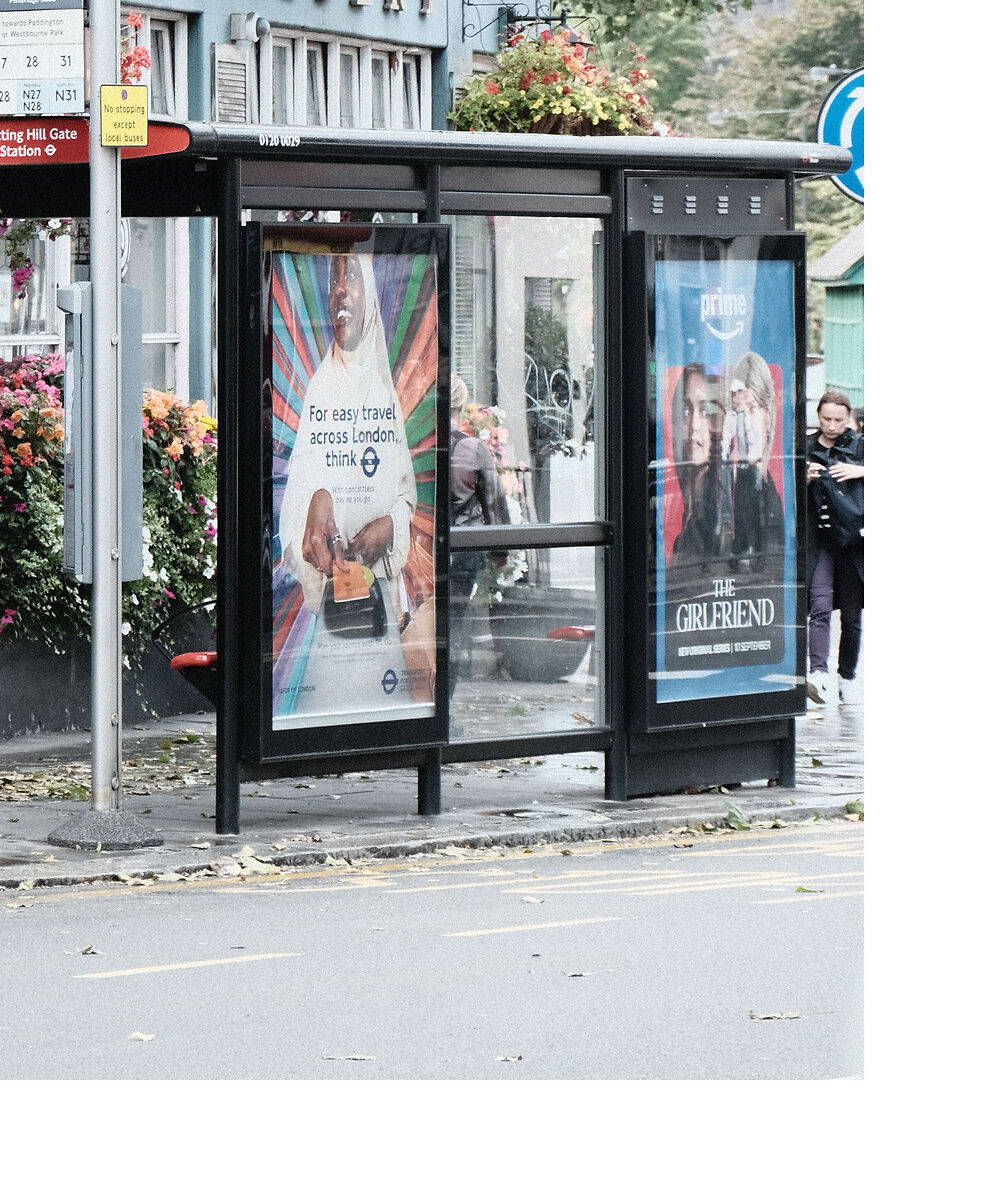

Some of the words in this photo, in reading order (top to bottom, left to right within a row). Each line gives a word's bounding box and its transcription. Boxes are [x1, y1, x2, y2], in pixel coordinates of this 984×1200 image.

[2, 19, 27, 27] towards
[28, 18, 65, 27] Paddington
[10, 30, 48, 38] Westbourne
[50, 29, 64, 37] Park
[25, 55, 39, 68] 28
[60, 55, 72, 67] 31
[22, 89, 41, 100] N27
[55, 89, 78, 102] N31
[23, 101, 42, 111] N28
[104, 104, 114, 114] No
[116, 105, 145, 115] stopping
[113, 121, 136, 129] except
[26, 127, 47, 141] Hill
[49, 127, 78, 140] Gate
[105, 133, 122, 142] local
[124, 132, 144, 142] buses
[259, 134, 280, 146] 0120
[280, 135, 301, 147] 0029
[0, 144, 41, 157] Station
[701, 286, 747, 322] prime
[309, 405, 328, 422] For
[332, 407, 359, 425] easy
[361, 403, 397, 421] travel
[310, 431, 349, 445] across
[325, 450, 357, 468] think
[344, 485, 375, 494] contactless
[336, 496, 345, 505] pay
[353, 496, 363, 505] you
[364, 496, 371, 505] go
[713, 579, 736, 598] THE
[676, 598, 775, 633] GIRLFRIEND
[678, 646, 689, 657] NEW
[689, 644, 713, 656] ORIGINAL
[713, 643, 731, 654] SERIES
[734, 642, 740, 652] 10
[740, 640, 771, 651] SEPTEMBER
